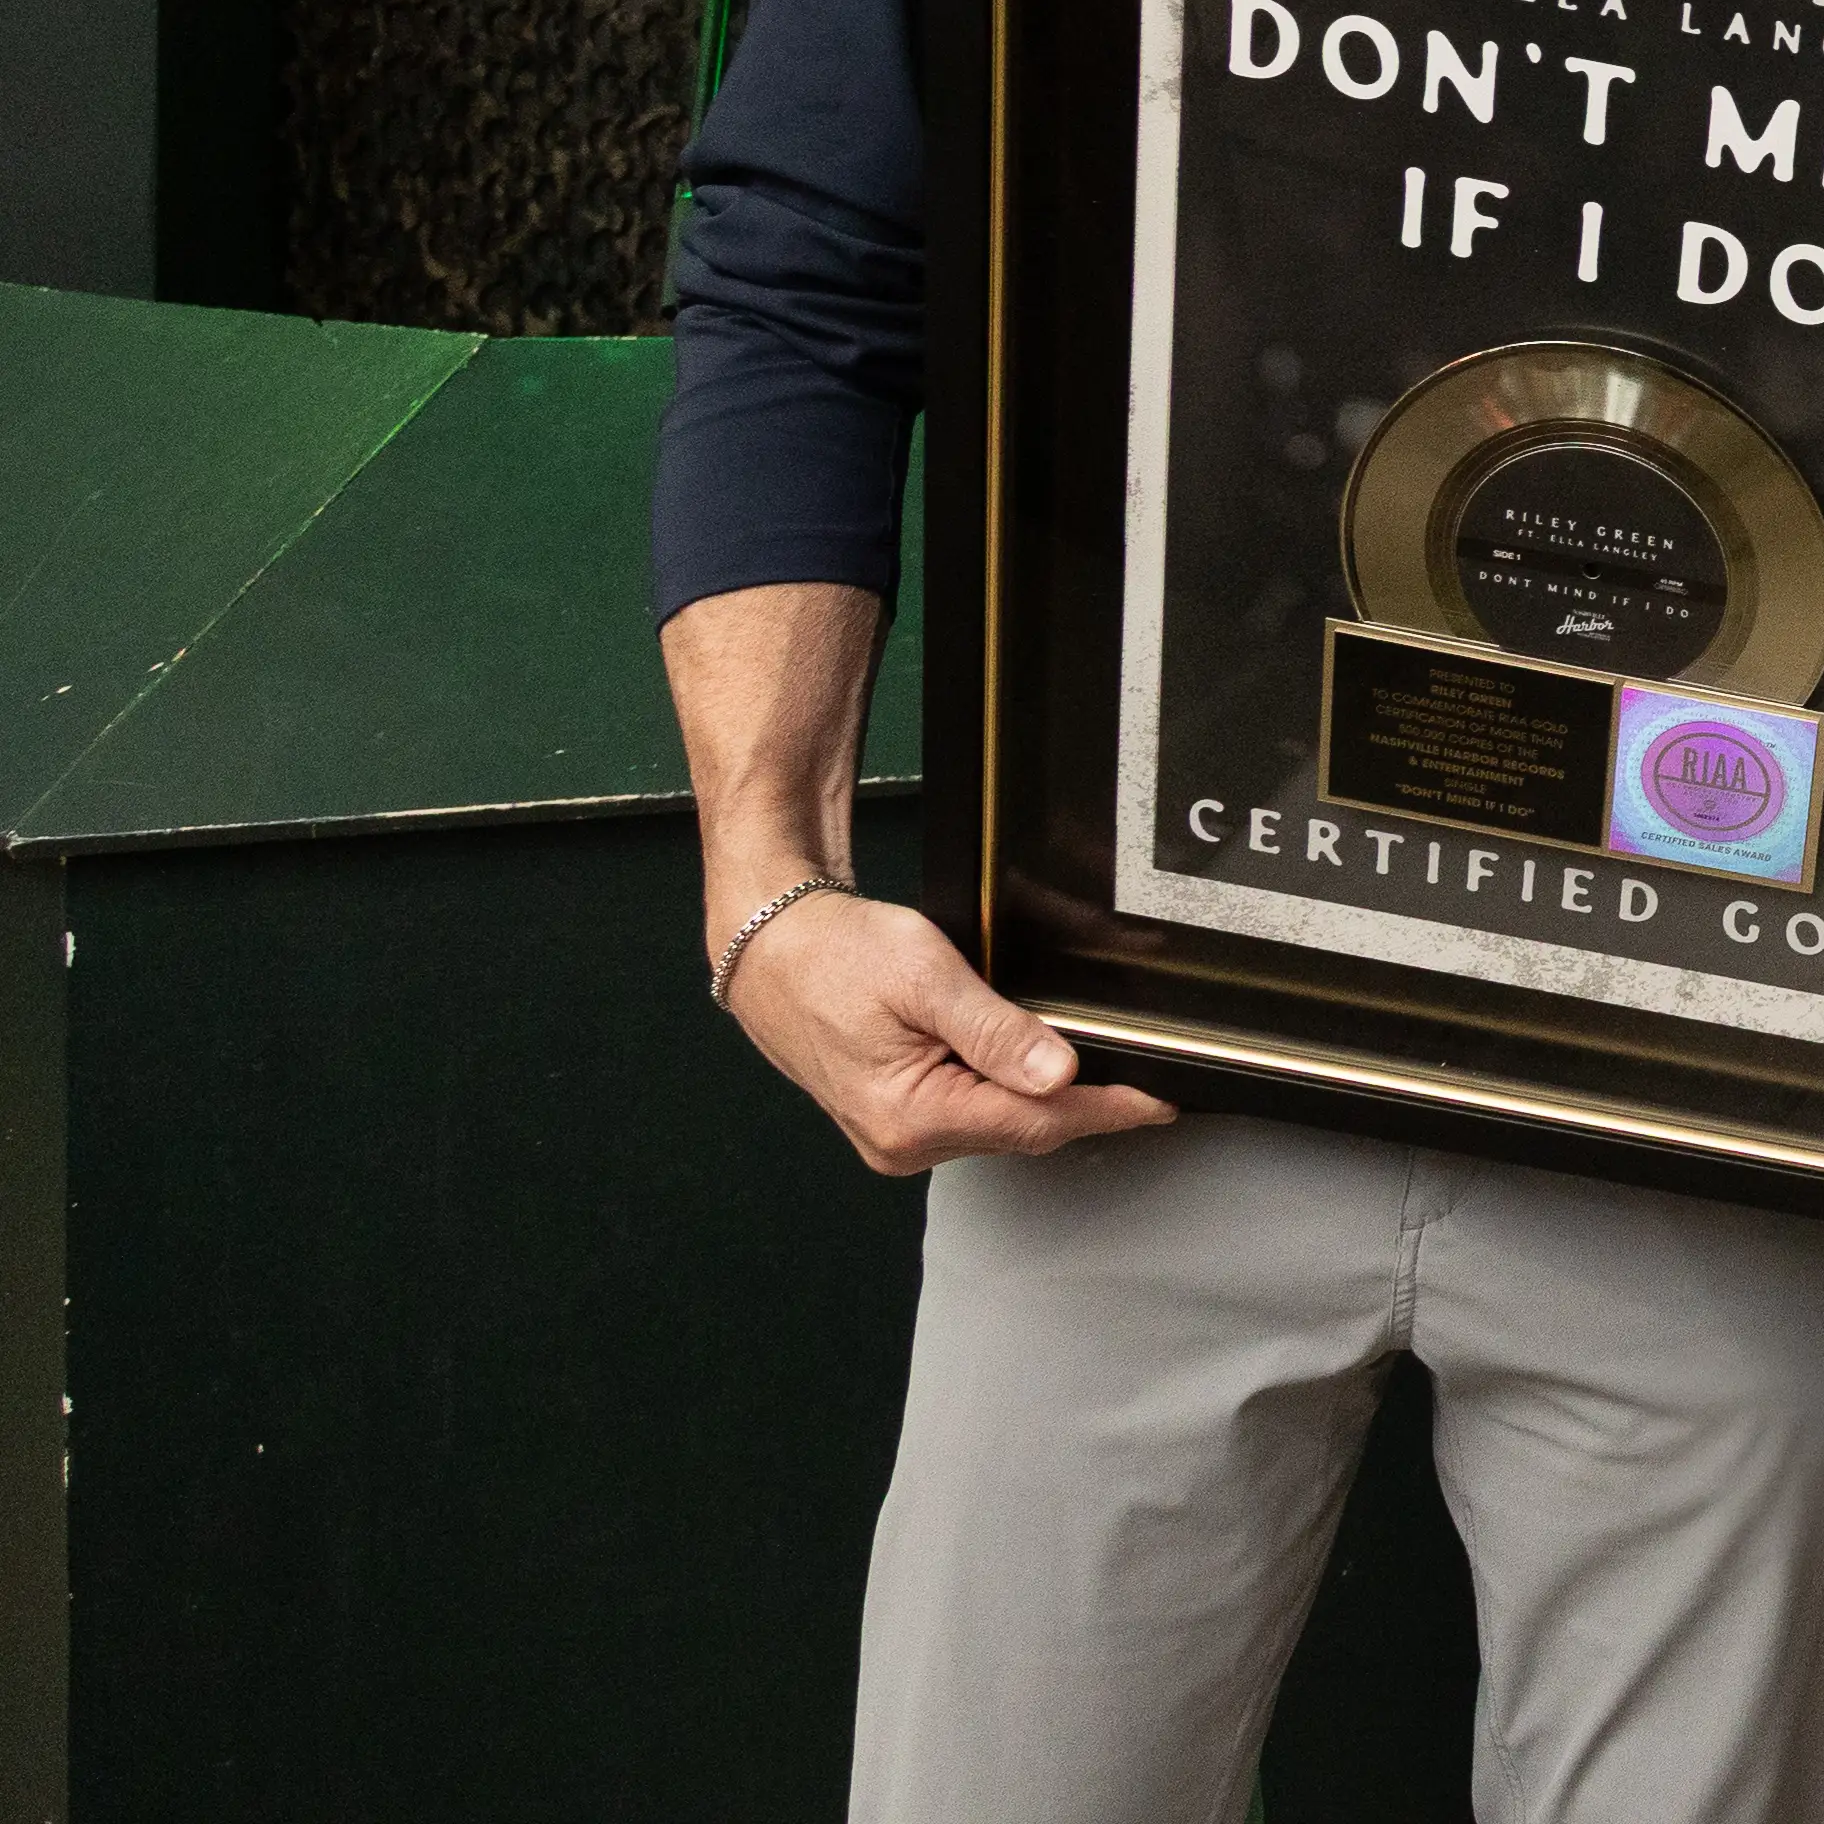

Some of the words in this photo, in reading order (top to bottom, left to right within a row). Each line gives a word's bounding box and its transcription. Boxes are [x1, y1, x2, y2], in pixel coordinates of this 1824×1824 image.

[1401, 166, 1510, 259] IF
[1577, 201, 1604, 283] I
[1506, 509, 1577, 532] RILEY
[1597, 526, 1675, 550] GREEN
[1518, 528, 1540, 539] FT.
[1550, 534, 1584, 548] ELLA
[1593, 542, 1658, 561] LANGLEY
[1493, 549, 1515, 560] SIDE
[1548, 583, 1597, 600] MIND
[1612, 595, 1630, 606] IF
[1666, 606, 1689, 618] DO
[1556, 614, 1615, 635] Harbor
[1430, 685, 1464, 699] RILEY
[1468, 692, 1513, 709] GREEN
[1370, 733, 1440, 755] NASHVILLE
[1443, 747, 1499, 767] HARBOR
[1503, 759, 1565, 780] RECORDS
[1422, 757, 1525, 787] ENTERTAINMENT
[1681, 747, 1747, 790] RIAA
[1446, 792, 1482, 809] MIND
[1189, 798, 1659, 923] CERTIFIED
[1641, 831, 1696, 848] CERTIFIED
[1698, 841, 1731, 855] SALES
[1733, 848, 1772, 862] AWARD
